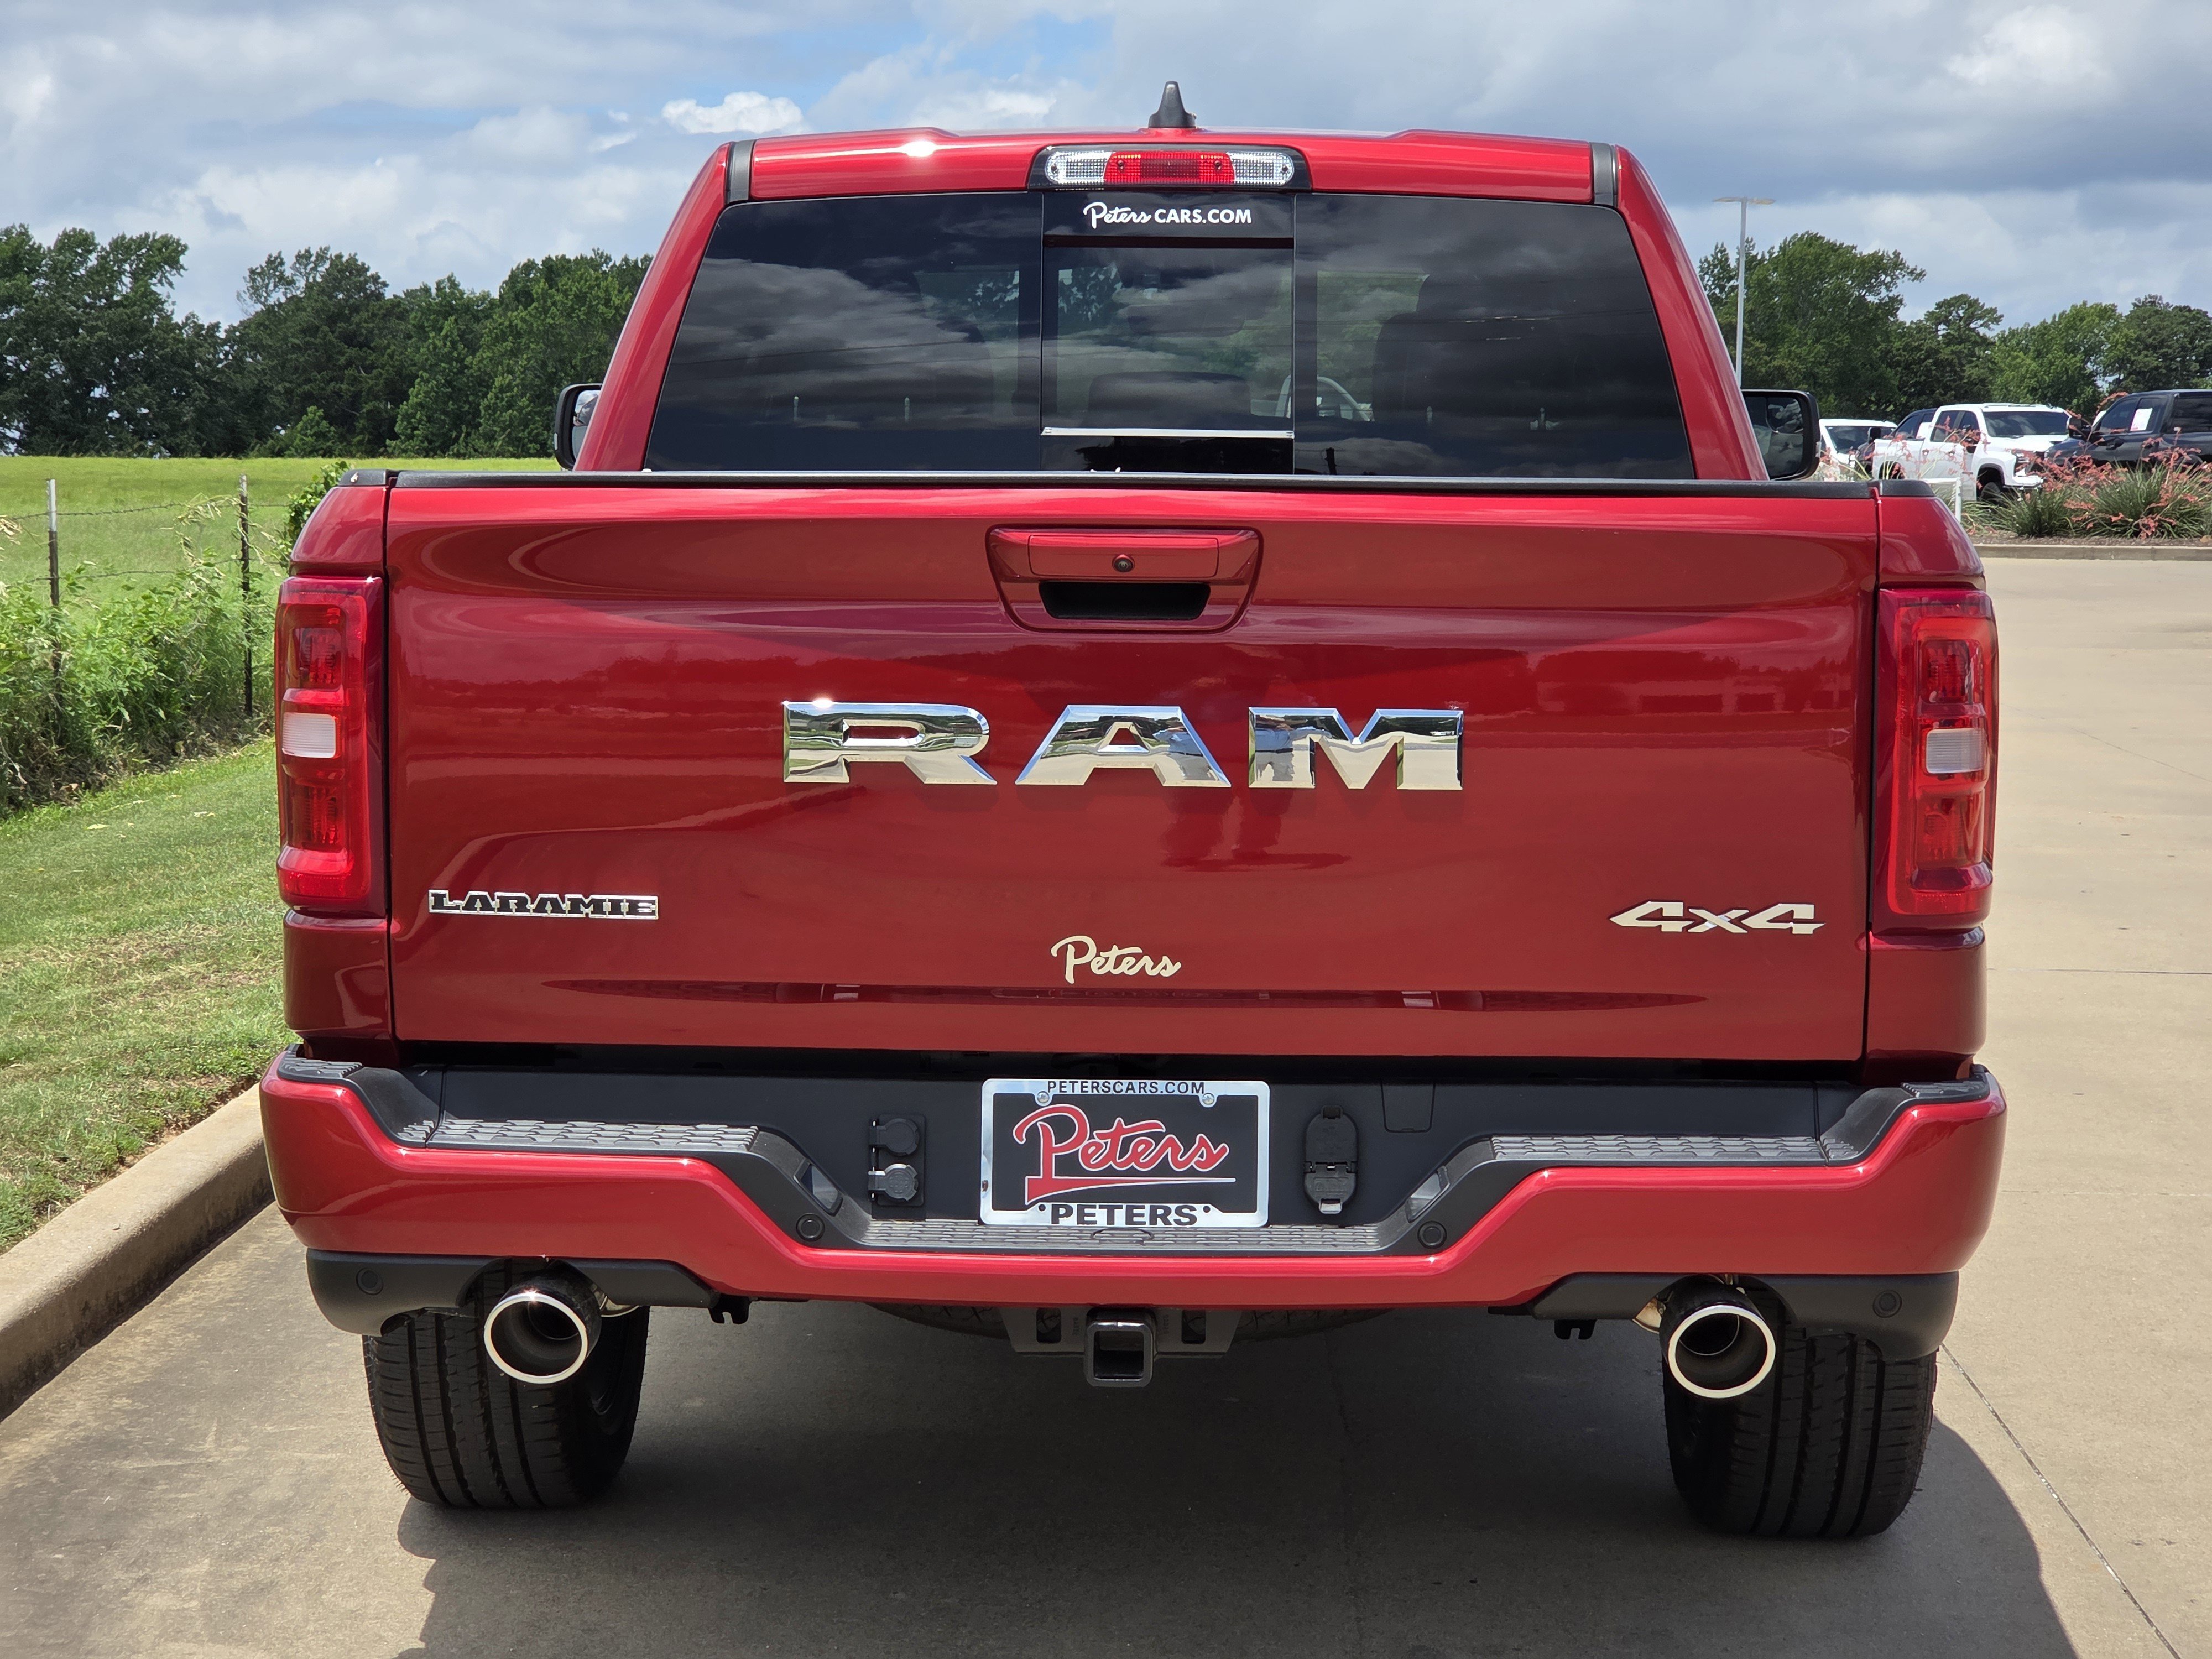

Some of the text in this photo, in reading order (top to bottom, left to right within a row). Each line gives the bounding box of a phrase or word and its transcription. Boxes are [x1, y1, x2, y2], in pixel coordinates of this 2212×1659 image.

[1083, 201, 1252, 229] Peters CARS.COM
[782, 701, 1464, 791] RAM
[428, 889, 659, 920] LARAMIE
[1609, 900, 1825, 935] 4x4
[1051, 935, 1182, 984] Peters
[1047, 1081, 1205, 1095] PETERSCARS.COM
[1013, 1104, 1229, 1181] Peters
[1051, 1204, 1198, 1227] PETERS
